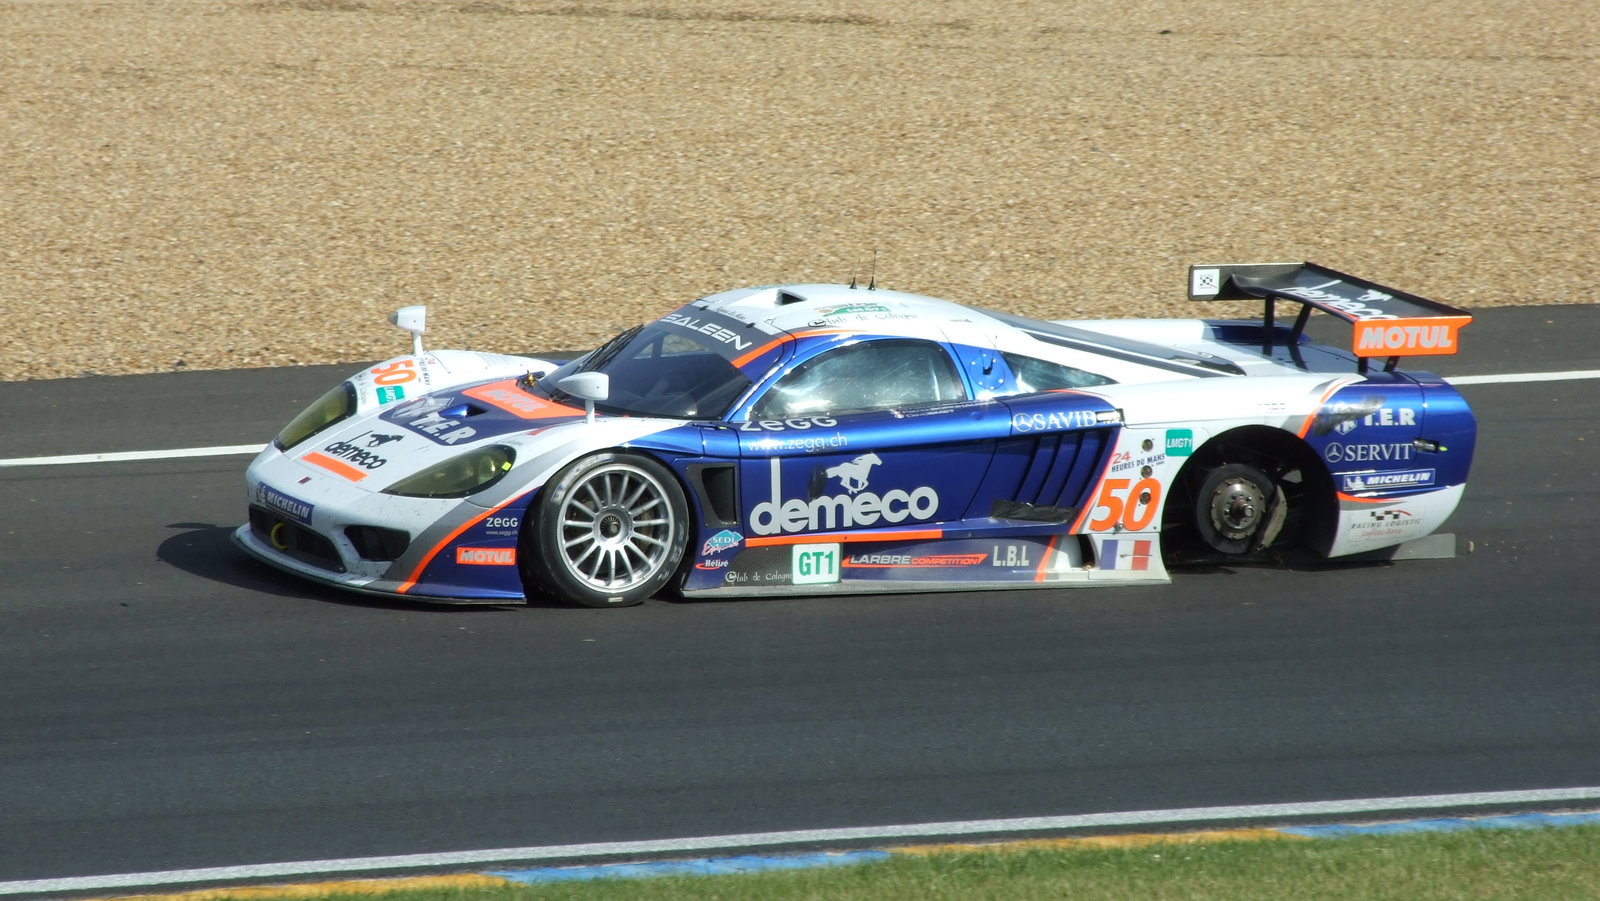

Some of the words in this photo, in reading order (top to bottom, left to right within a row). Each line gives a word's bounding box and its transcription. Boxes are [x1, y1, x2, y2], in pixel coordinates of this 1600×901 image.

[660, 313, 752, 351] SALEEN
[1359, 325, 1453, 349] MOTUL
[370, 359, 417, 386] 50
[323, 430, 388, 470] demeco
[1167, 438, 1193, 449] LMGT1
[1345, 443, 1414, 462] SERVIT
[1111, 461, 1135, 473] HEURES
[1137, 458, 1146, 468] DU
[1147, 453, 1166, 464] MANS
[1113, 451, 1132, 465] 24
[1367, 472, 1431, 486] MICHELIN
[266, 491, 311, 519] MICHELIN
[750, 457, 939, 536] demeco
[1088, 477, 1162, 532] 50
[1351, 522, 1383, 530] RACING
[461, 550, 513, 564] MOTUL
[799, 551, 835, 576] GT1
[850, 555, 911, 565] LARBRE
[911, 557, 979, 566] COMPETITION
[752, 571, 761, 581] de
